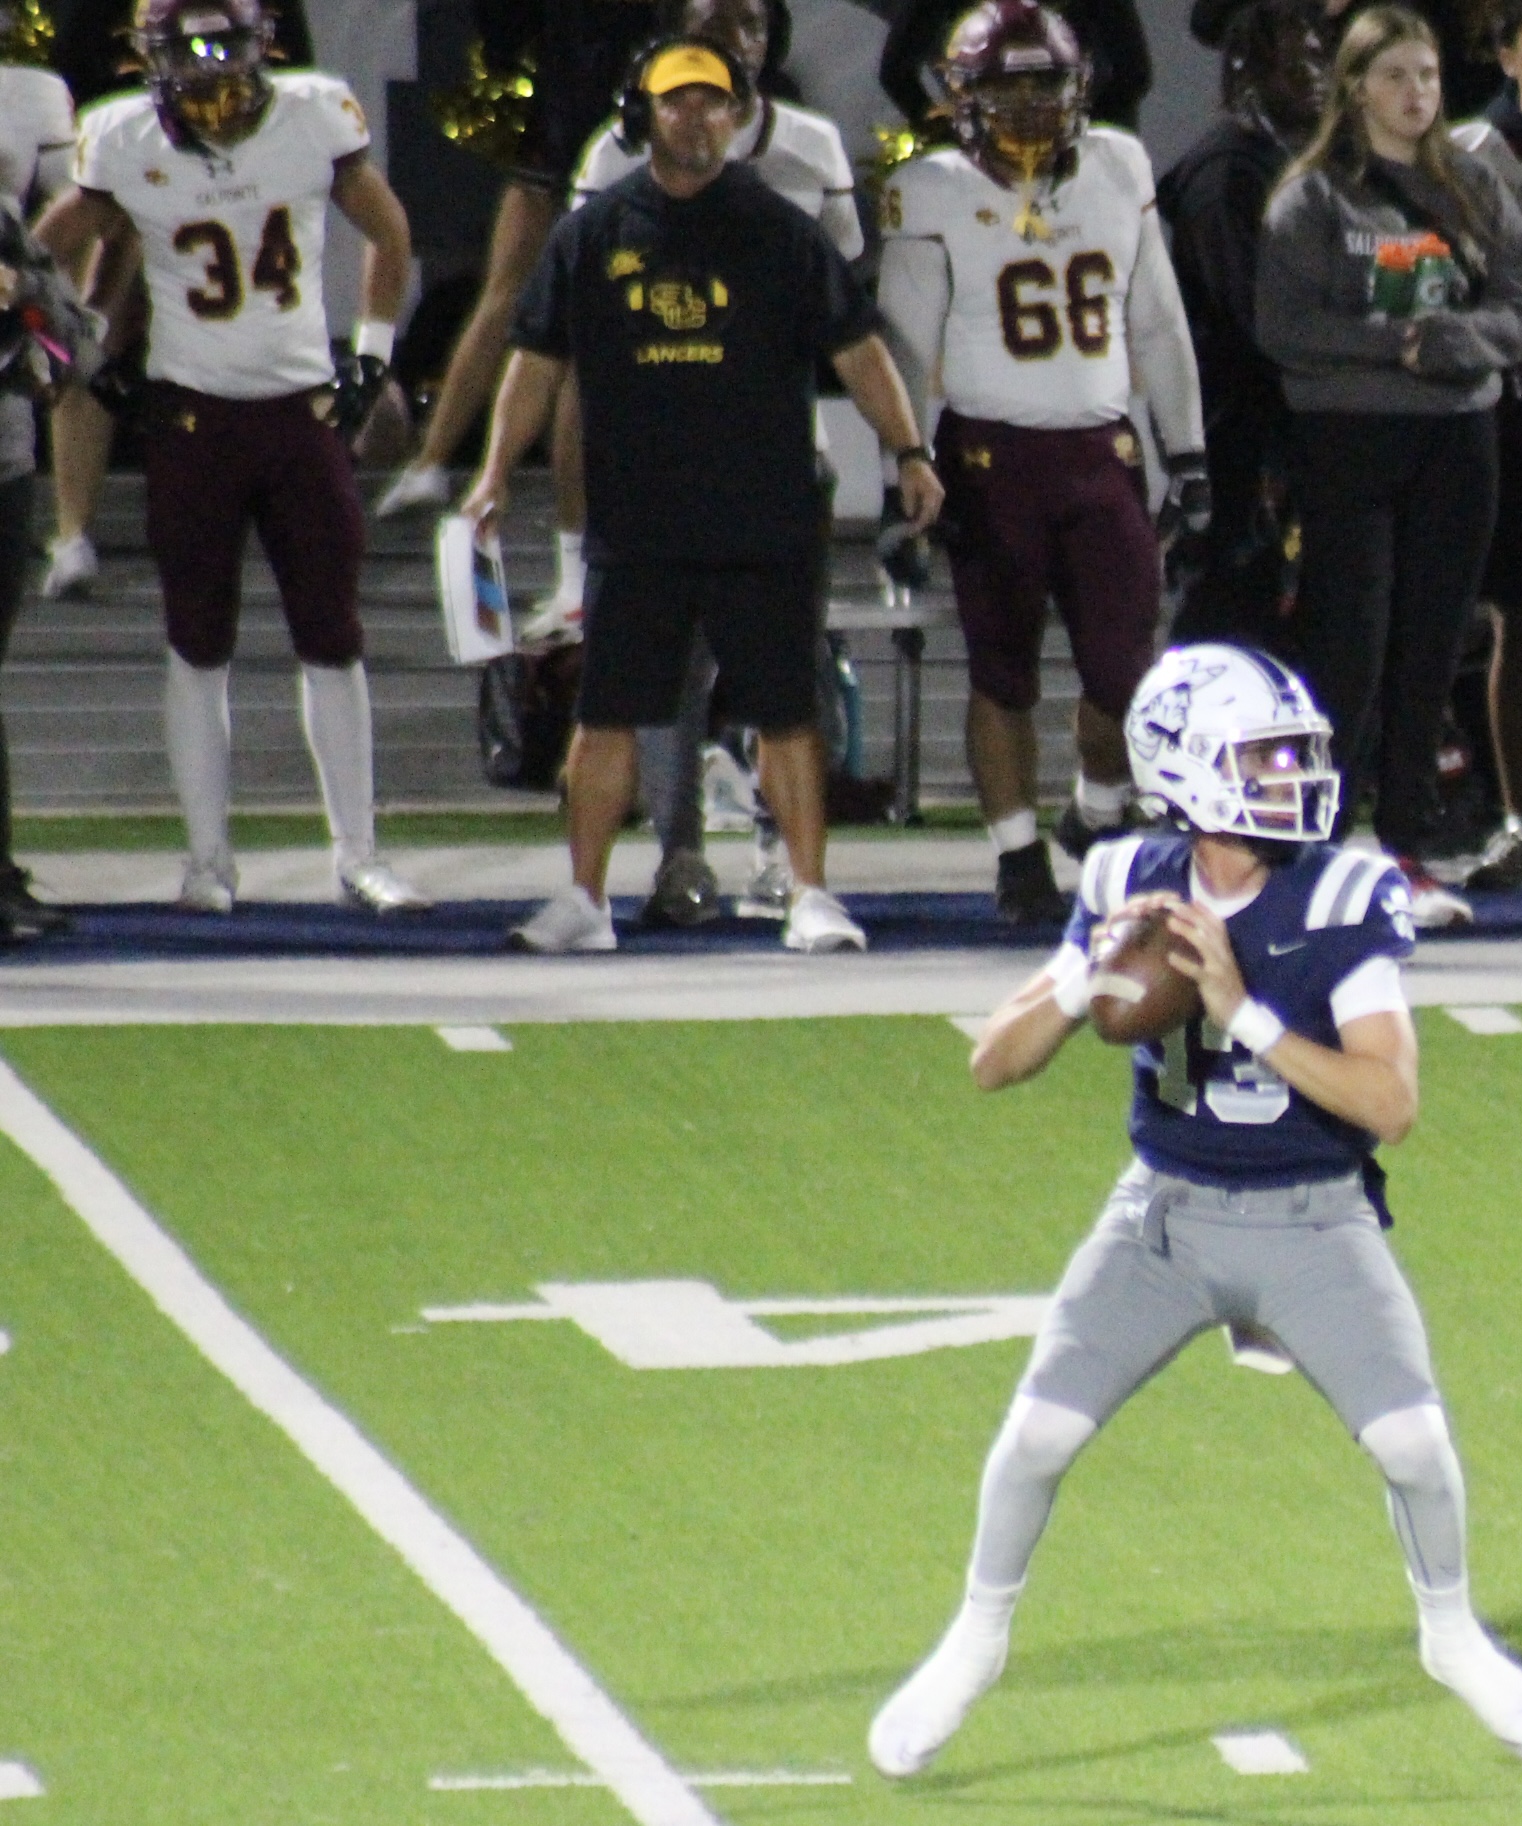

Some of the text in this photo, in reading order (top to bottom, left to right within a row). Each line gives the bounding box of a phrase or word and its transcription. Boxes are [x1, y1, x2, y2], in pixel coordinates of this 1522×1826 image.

[173, 203, 302, 321] 34
[996, 252, 1115, 362] 66
[1154, 1012, 1291, 1124] 13
